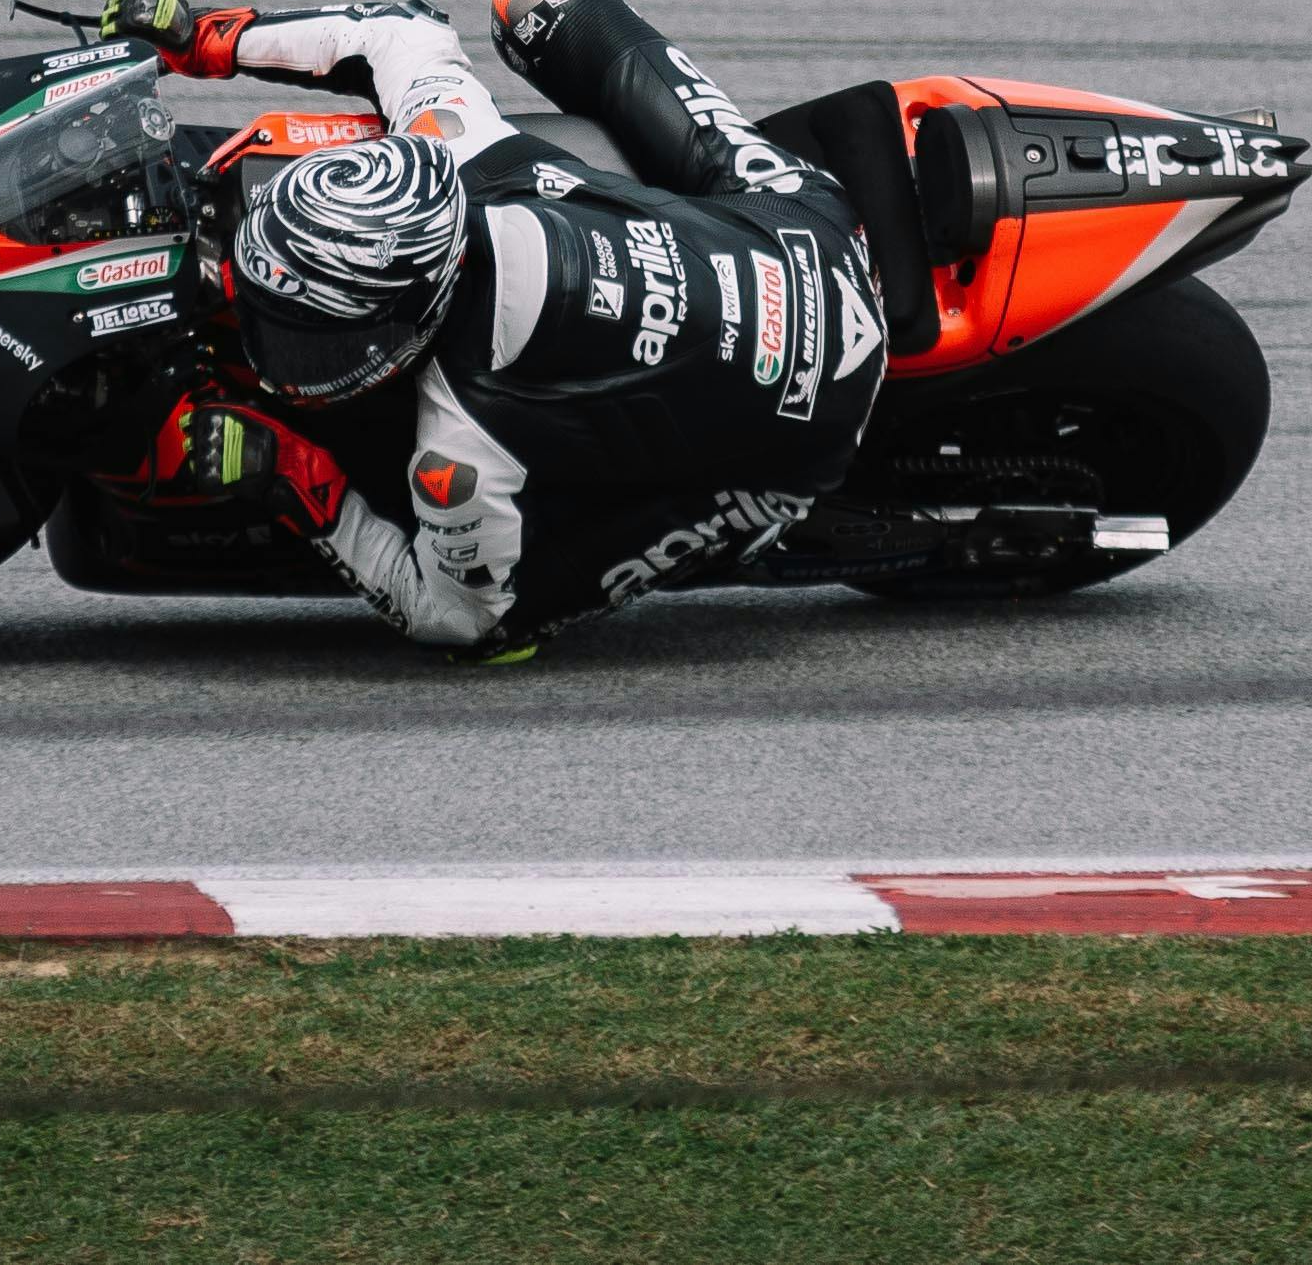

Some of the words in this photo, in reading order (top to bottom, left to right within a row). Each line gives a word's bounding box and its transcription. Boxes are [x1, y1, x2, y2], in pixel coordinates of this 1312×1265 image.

[48, 72, 112, 103] Castrol
[1105, 126, 1288, 186] apilia
[99, 255, 167, 285] Castrol
[591, 230, 607, 277] PIAGGIO
[601, 235, 619, 279] GROUP
[661, 221, 689, 321] RACING
[93, 302, 171, 330] DELLORTO
[625, 220, 680, 366] aprilia
[722, 272, 737, 317] wifi
[761, 260, 782, 352] Castrol
[794, 246, 816, 365] MICHELIN
[721, 323, 739, 361] sky
